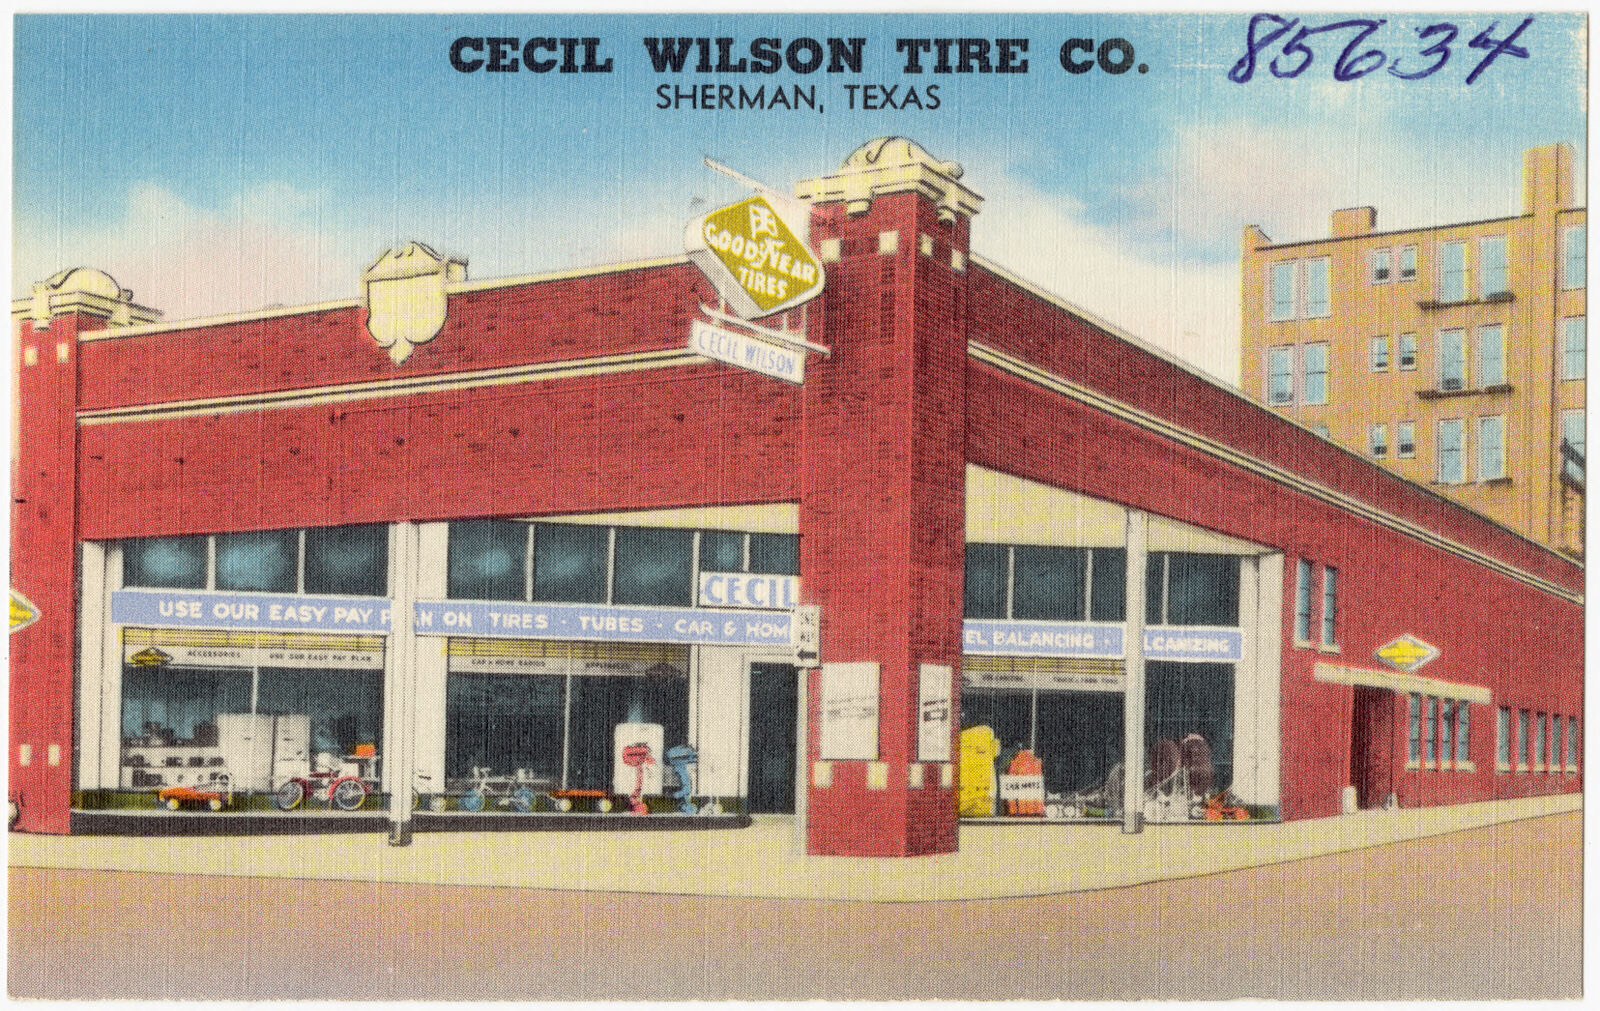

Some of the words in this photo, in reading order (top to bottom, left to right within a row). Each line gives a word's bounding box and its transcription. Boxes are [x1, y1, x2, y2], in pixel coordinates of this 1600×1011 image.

[1228, 13, 1535, 84] 85634
[704, 222, 815, 285] GOODYEAR
[738, 265, 789, 299] TIRES
[699, 329, 740, 359] CECIL
[744, 349, 796, 375] WILSON
[705, 575, 796, 608] CECIL
[159, 600, 203, 619] USE
[213, 602, 259, 622] OUR
[269, 604, 328, 624] EASY
[334, 606, 374, 625] PAY
[443, 610, 473, 628] ON
[488, 612, 549, 630] TIRES
[579, 614, 644, 633] TUBES
[674, 617, 713, 635] CAR
[723, 620, 737, 636] &
[187, 650, 242, 658] ACCESSORIES
[992, 630, 1095, 650] BALANCING
